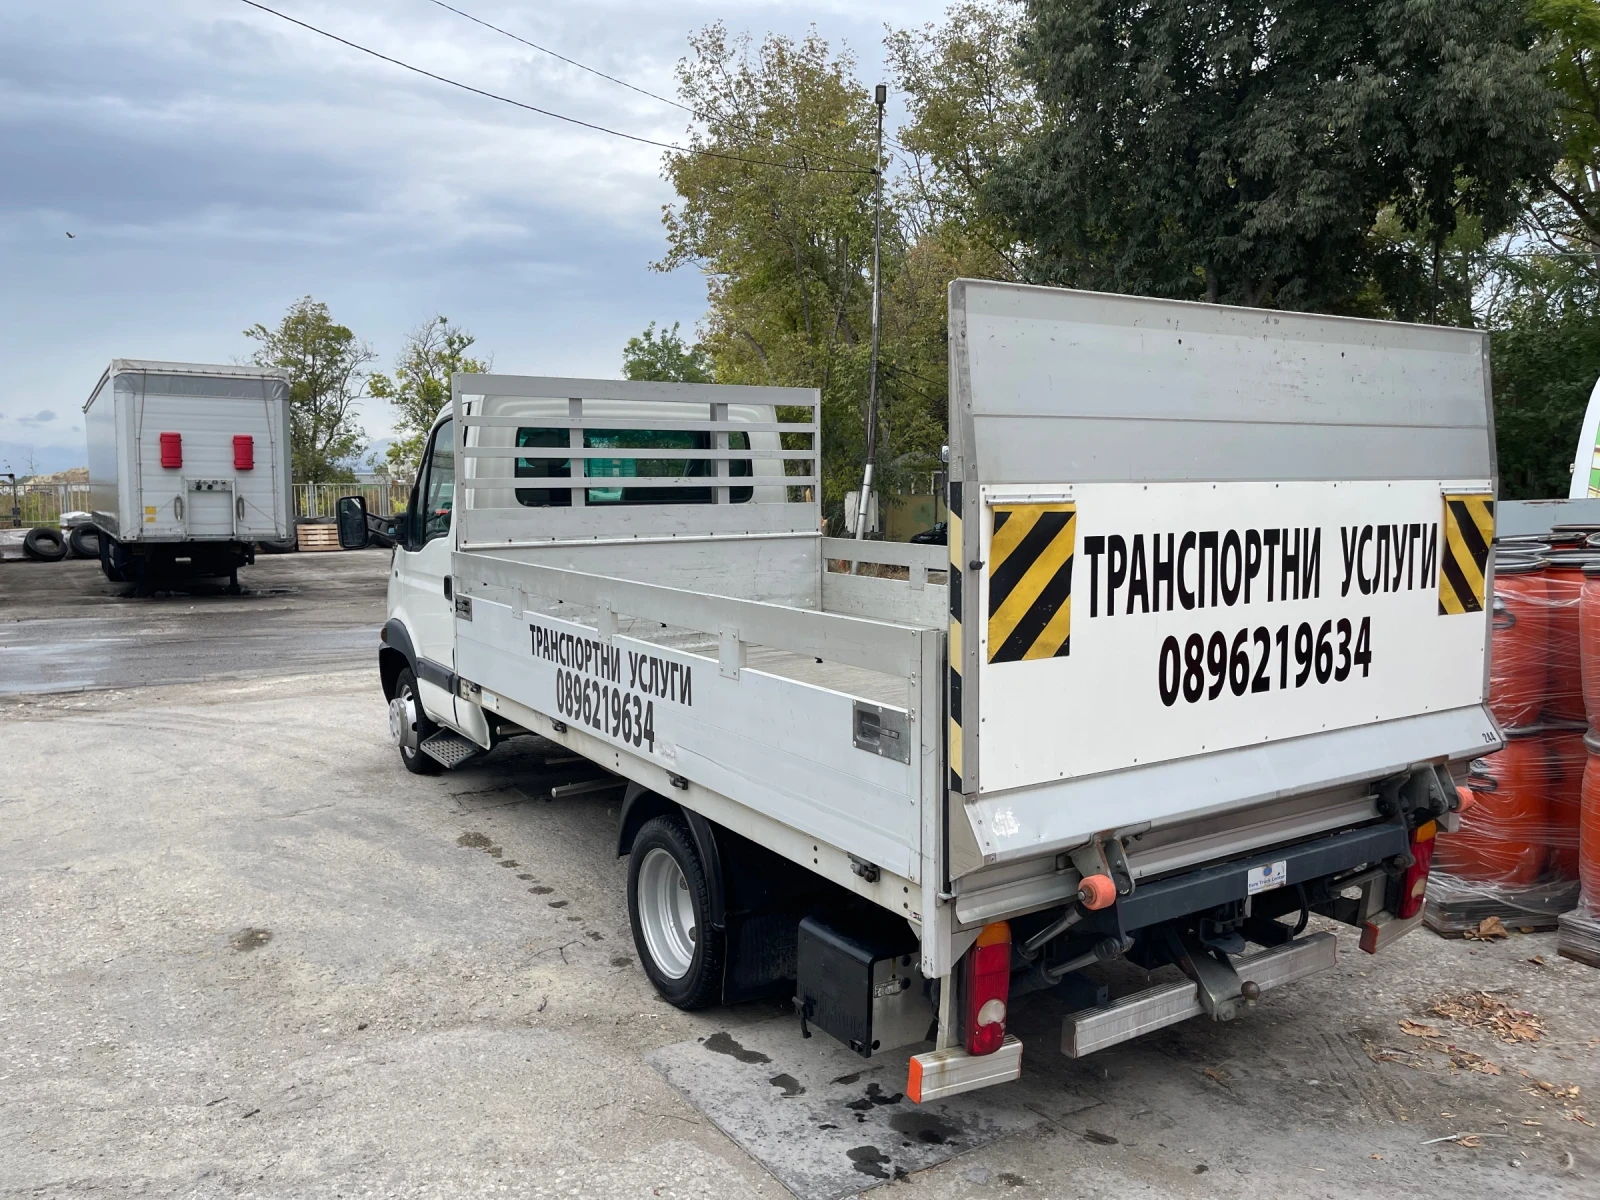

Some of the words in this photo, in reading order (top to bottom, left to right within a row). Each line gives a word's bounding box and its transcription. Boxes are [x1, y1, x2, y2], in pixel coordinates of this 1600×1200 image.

[1083, 527, 1321, 618] ТРАНСПОРТНИ
[1340, 522, 1438, 598] УСЛУГИ
[529, 623, 621, 684] ТРАНСПОРТНИ
[628, 650, 692, 707] УСЛУГИ
[1158, 616, 1372, 707] 0896219634
[556, 668, 655, 753] 0896219634
[1482, 731, 1497, 743] 244
